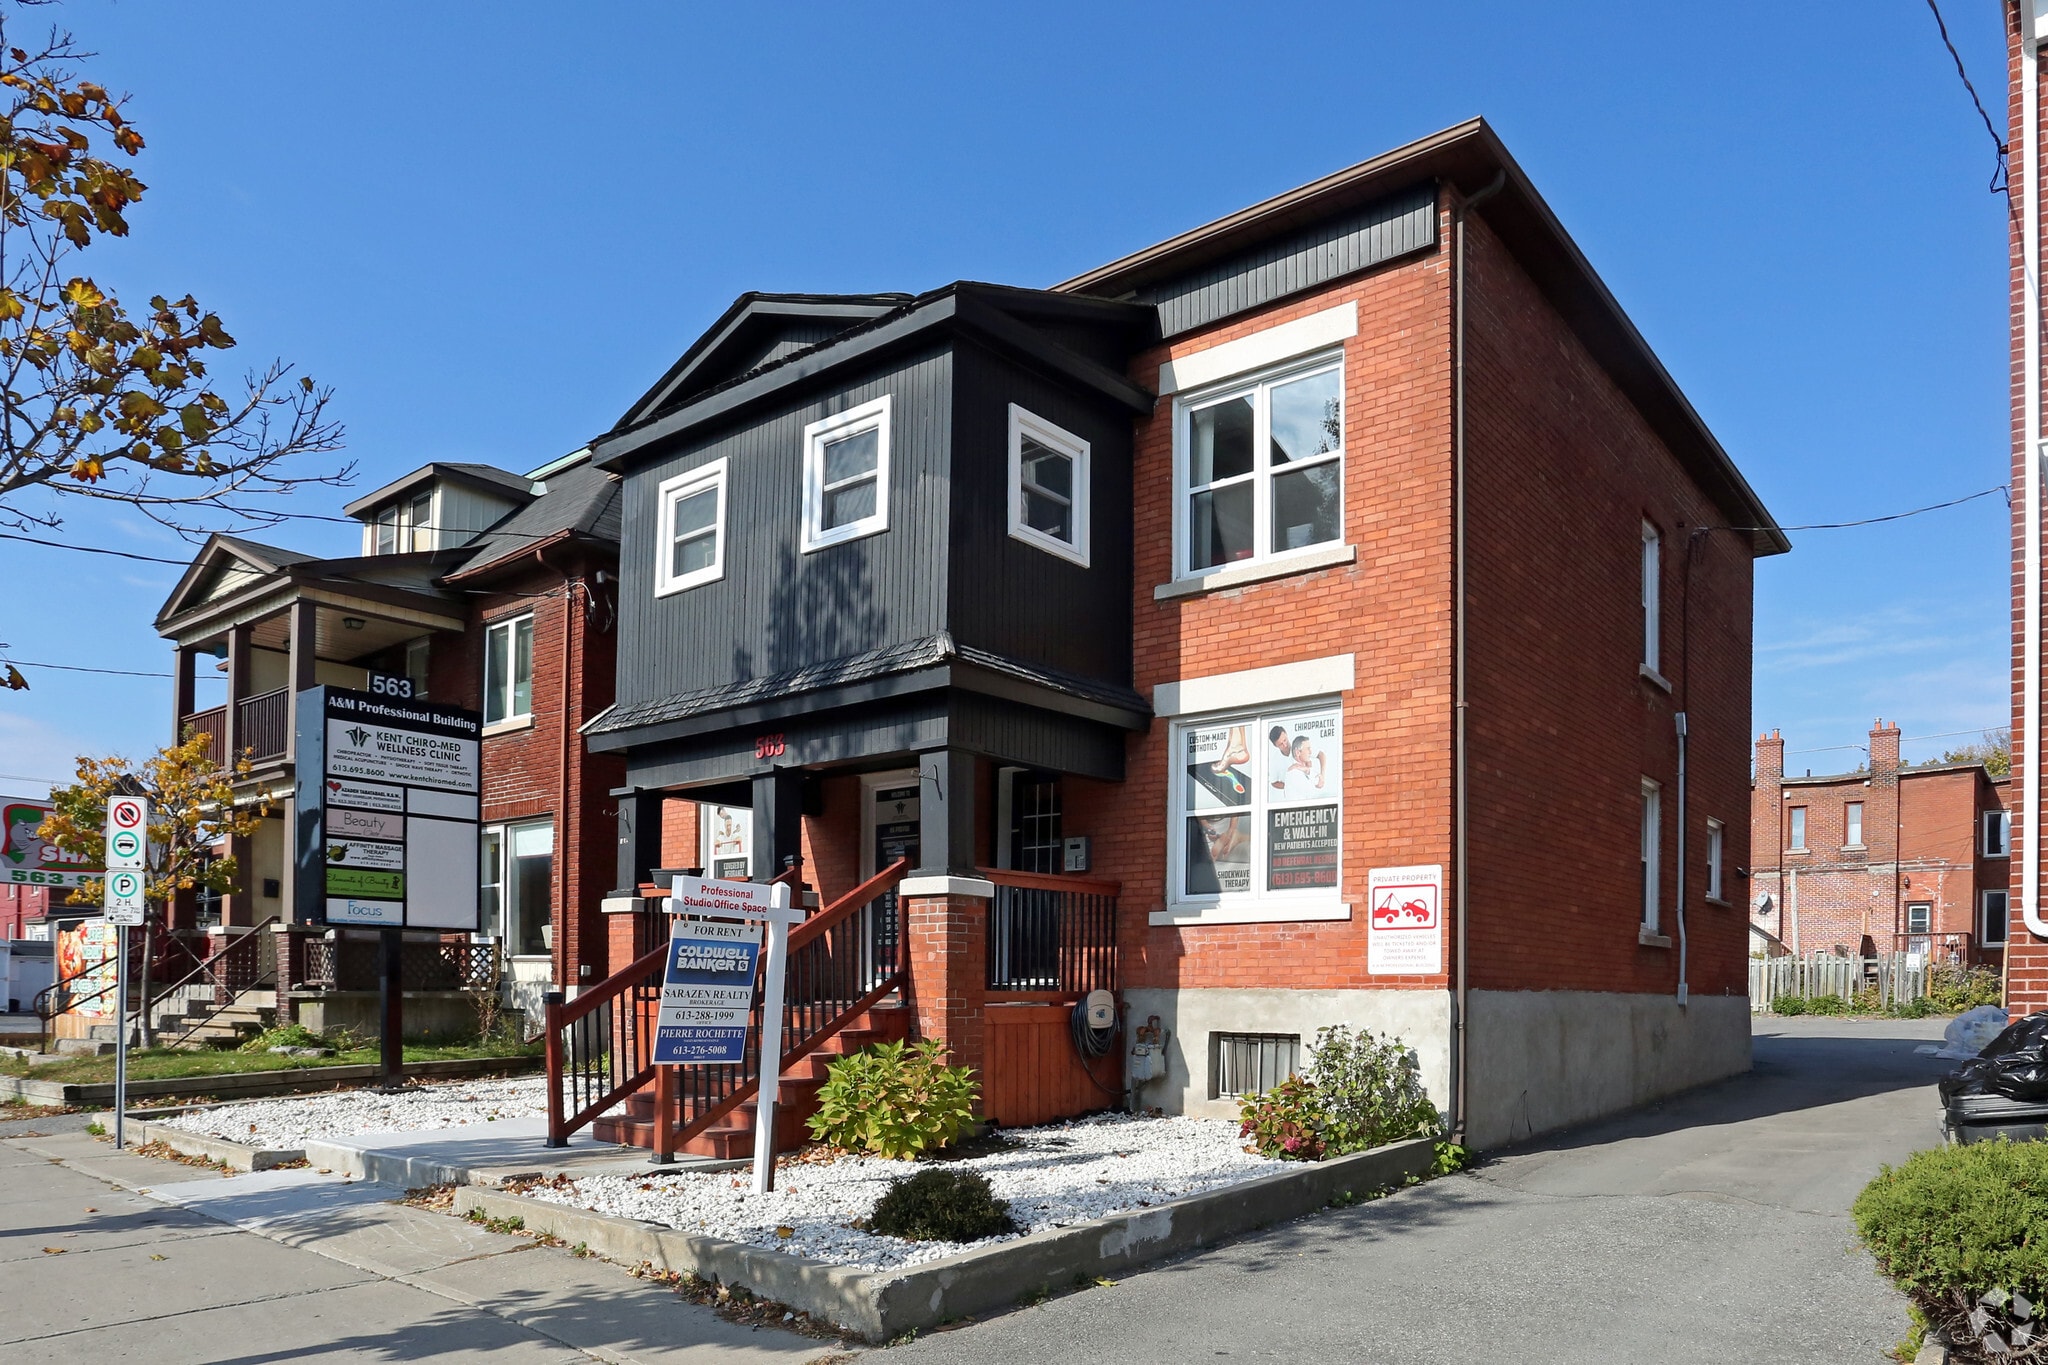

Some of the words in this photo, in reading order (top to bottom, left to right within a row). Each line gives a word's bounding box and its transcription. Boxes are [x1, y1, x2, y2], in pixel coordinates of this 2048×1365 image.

[372, 675, 412, 698] 563
[328, 696, 355, 710] A&M
[358, 700, 430, 722] Professional
[433, 713, 477, 732] Building
[1294, 718, 1335, 732] CHIROPRACTIC
[1189, 731, 1227, 745] CUSTOM-MADE
[1320, 728, 1335, 738] CARE
[376, 731, 402, 744] KENT
[405, 736, 461, 752] CHIRO-MED
[755, 733, 786, 760] 563
[1189, 742, 1218, 753] ORTHOTICS
[336, 748, 372, 758] CHIROPRACTOR
[380, 755, 416, 764] PHYSIOTHERAPY
[377, 742, 428, 758] WELLNESS
[429, 749, 461, 762] CLINIC
[354, 757, 387, 766] ACUPUNCTURE
[332, 764, 386, 777] 613.695.8600
[388, 772, 473, 789] www.kentchiromed.com
[344, 812, 385, 832] Beauty
[1274, 807, 1337, 828] EMERGENCY
[1283, 828, 1291, 840] &
[1291, 825, 1328, 840] WALK-IN
[374, 844, 402, 852] MASSAGE
[1273, 841, 1287, 851] NEW
[1286, 840, 1311, 850] PATIENTS
[1311, 838, 1338, 848] ACCEPTED
[363, 848, 389, 856] THERAPY
[327, 873, 356, 883] Elements
[357, 876, 363, 888] of
[364, 876, 389, 889] Beauty
[1217, 869, 1250, 880] SHOCKWAVE
[1272, 871, 1293, 887] (613)
[1294, 870, 1337, 885] 695-8600
[1373, 875, 1400, 883] PRIVATE
[1401, 873, 1437, 882] PROPERTY
[120, 880, 131, 892] P
[1224, 878, 1250, 888] THERAPY
[701, 884, 754, 899] Professional
[116, 898, 121, 906] 2
[683, 896, 740, 911] Studio/Office
[741, 902, 768, 914] Space
[694, 925, 715, 936] FOR
[716, 927, 744, 938] RENT
[664, 988, 711, 999] SARAZEN
[713, 990, 752, 1000] REALTY
[675, 1010, 735, 1021] 613-288-1999
[660, 1028, 694, 1039] PIERRE
[695, 1029, 744, 1039] ROCHETTE
[672, 1045, 728, 1056] 613-276-5008
